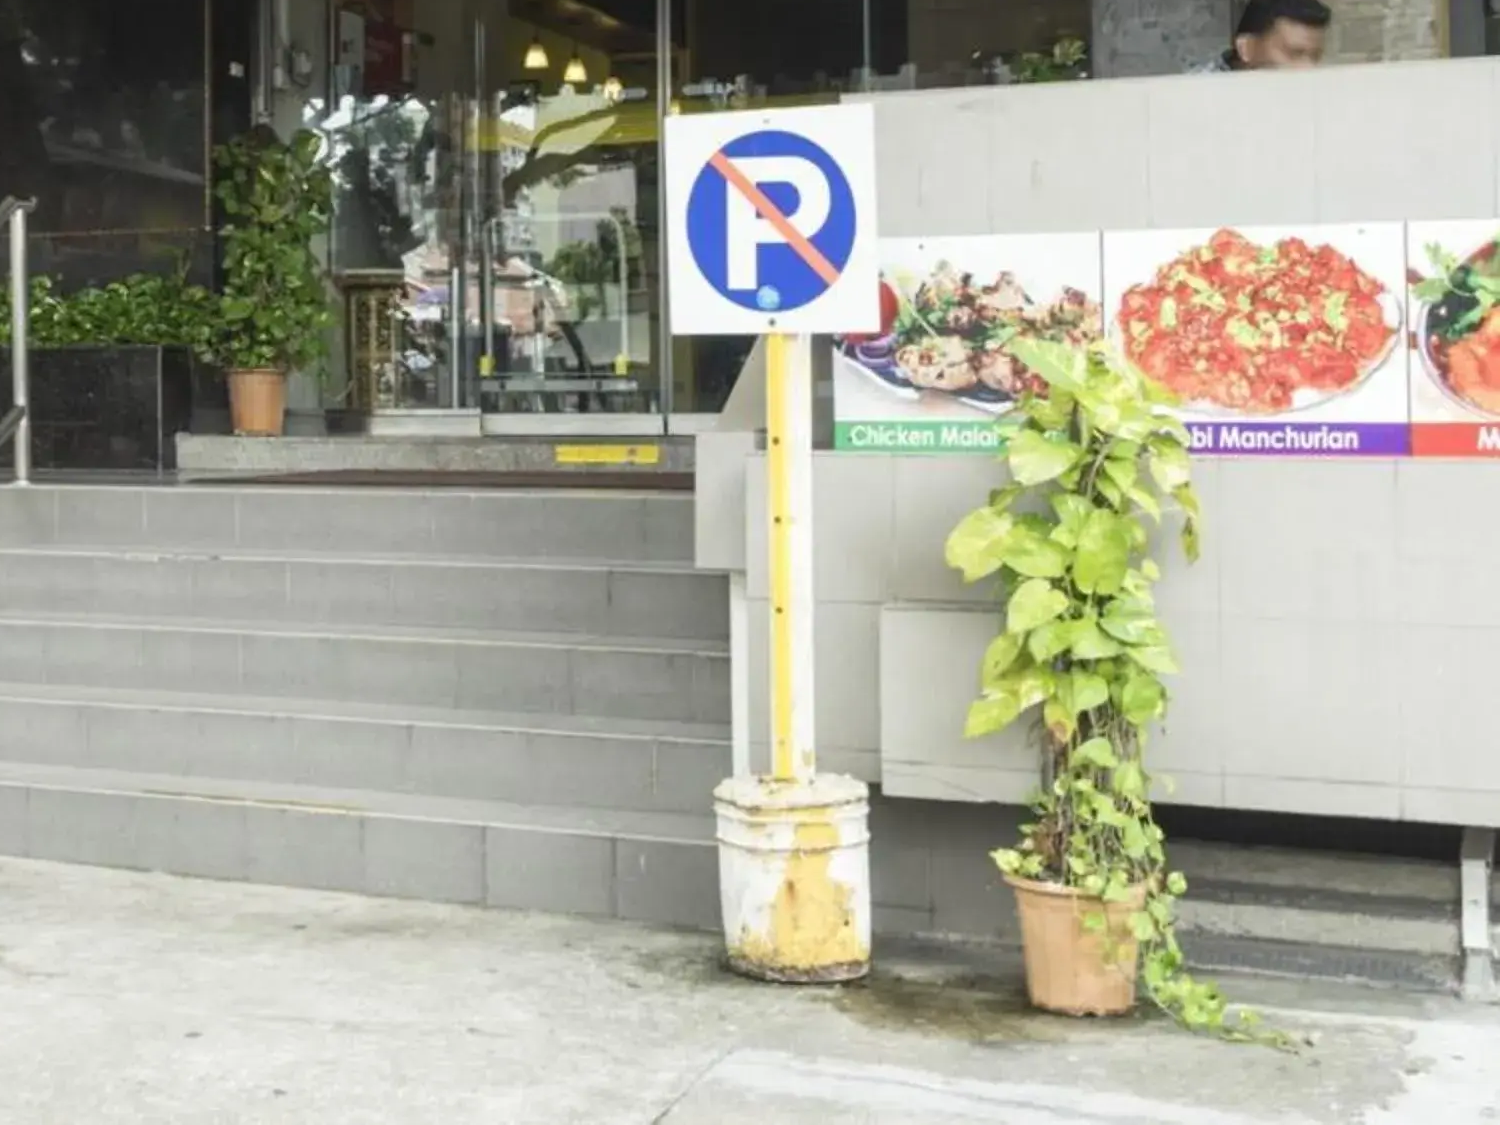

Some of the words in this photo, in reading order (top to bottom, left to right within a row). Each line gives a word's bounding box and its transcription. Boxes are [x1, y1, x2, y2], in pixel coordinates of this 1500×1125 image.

[728, 156, 831, 290] P
[851, 425, 934, 447] Chicken
[941, 425, 999, 447] Malai
[1220, 426, 1359, 449] Manchurian
